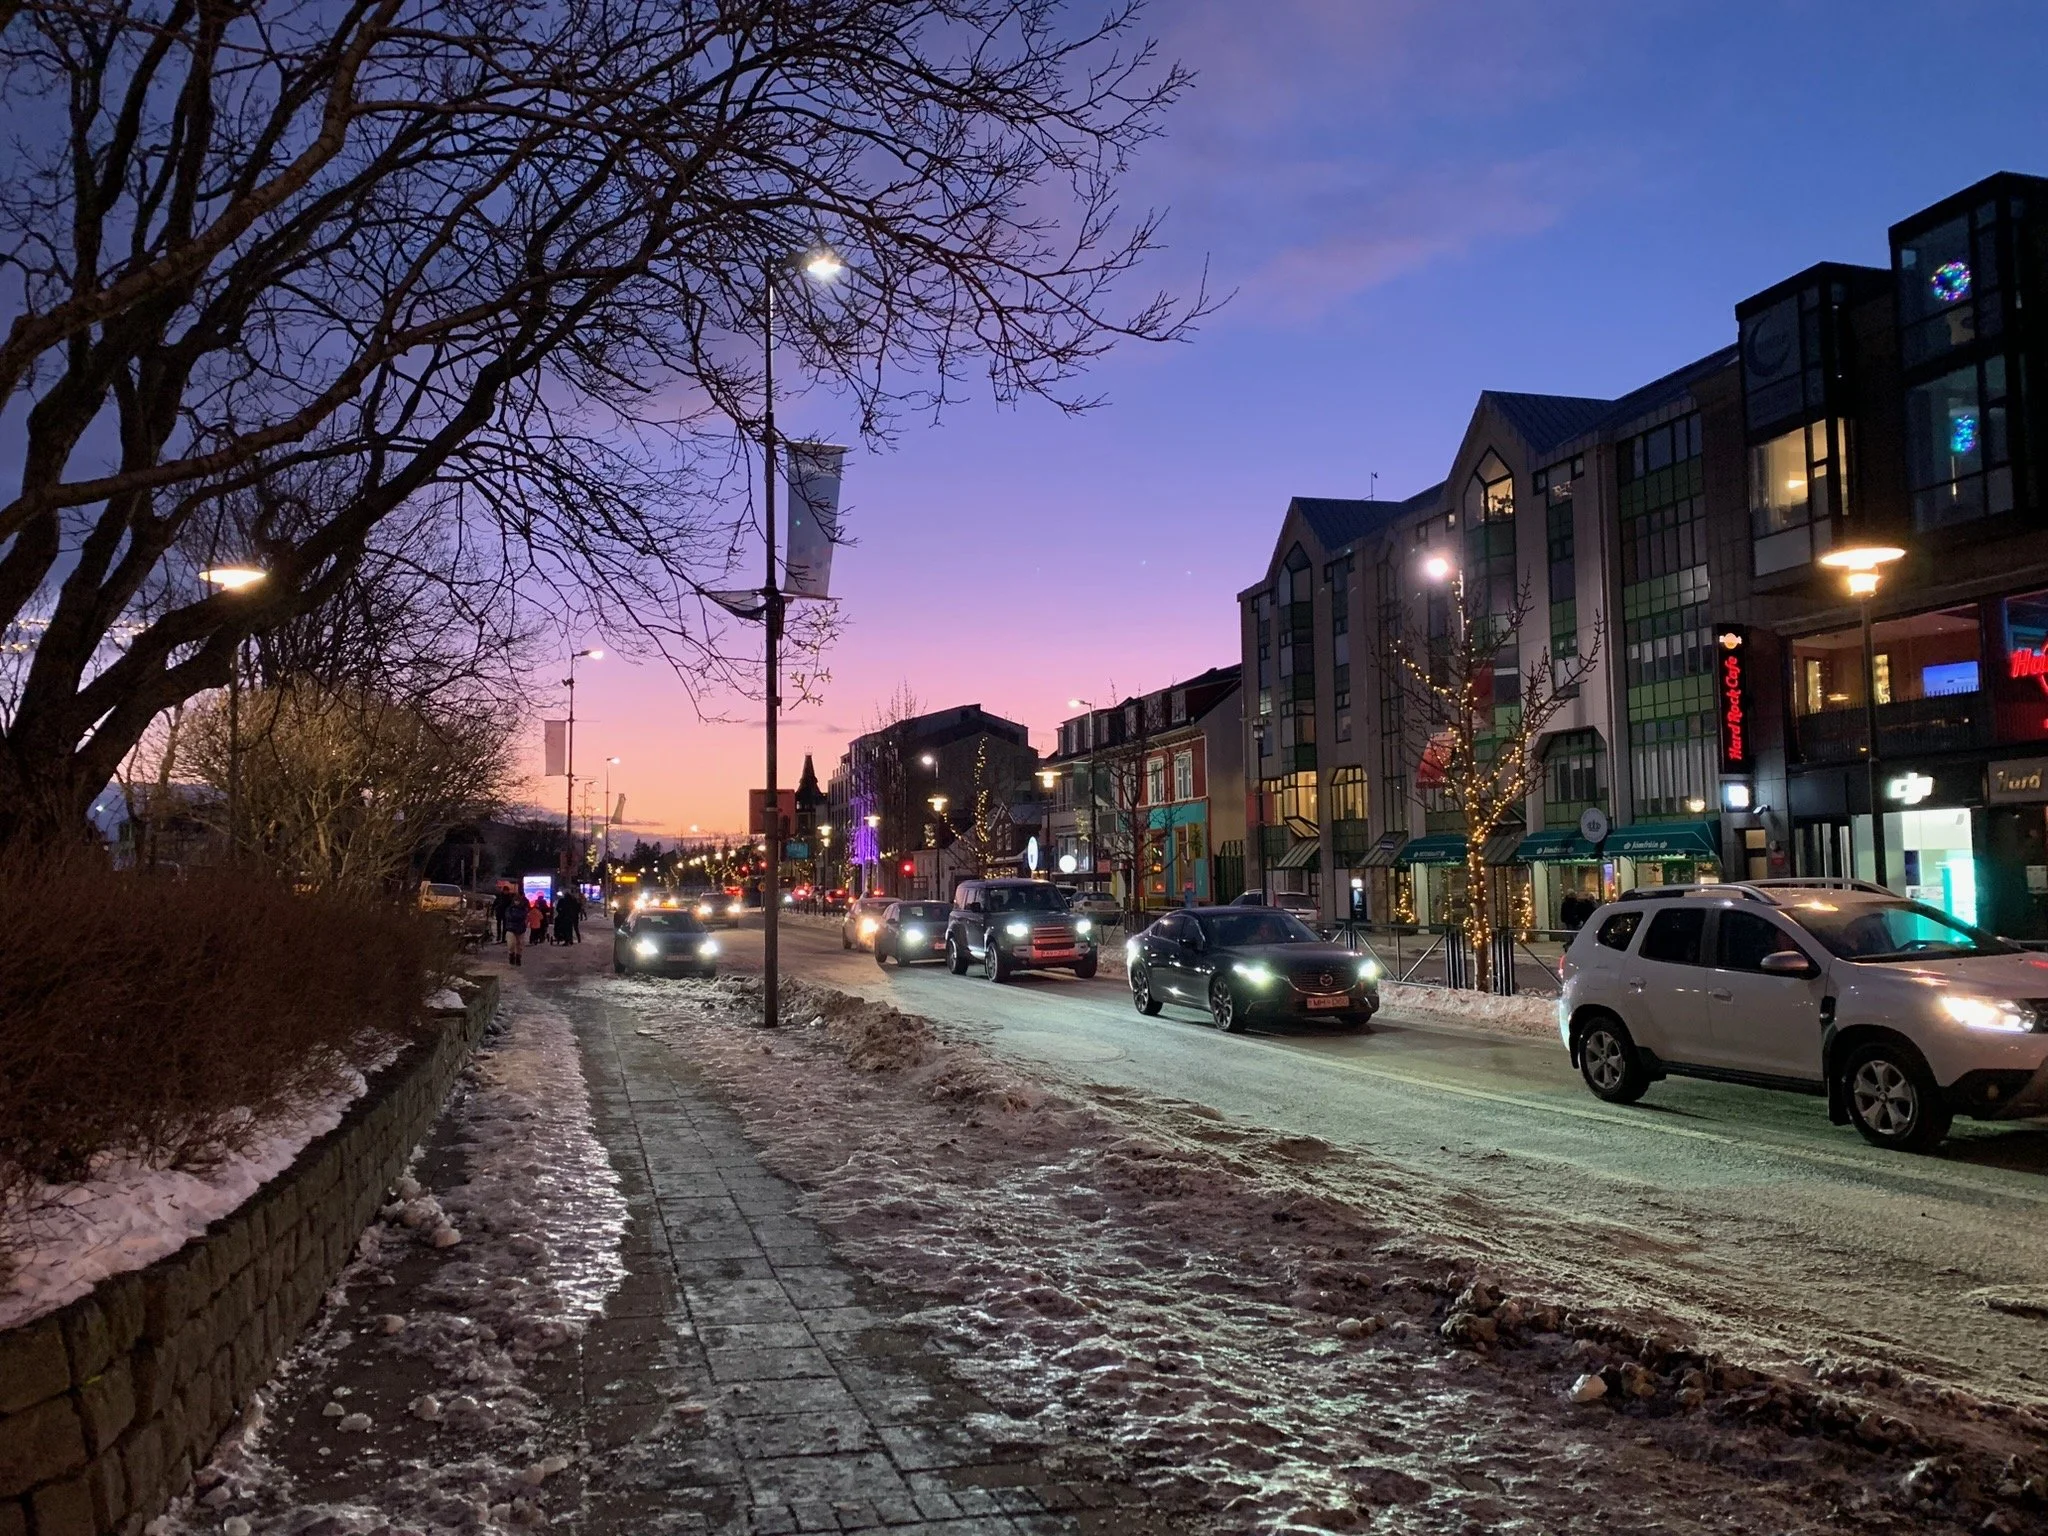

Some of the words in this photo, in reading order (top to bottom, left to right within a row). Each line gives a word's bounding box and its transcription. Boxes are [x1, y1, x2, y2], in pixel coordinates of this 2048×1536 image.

[1724, 656, 1740, 688] Cafe
[1727, 689, 1743, 722] Rock
[1728, 723, 1742, 760] Hard
